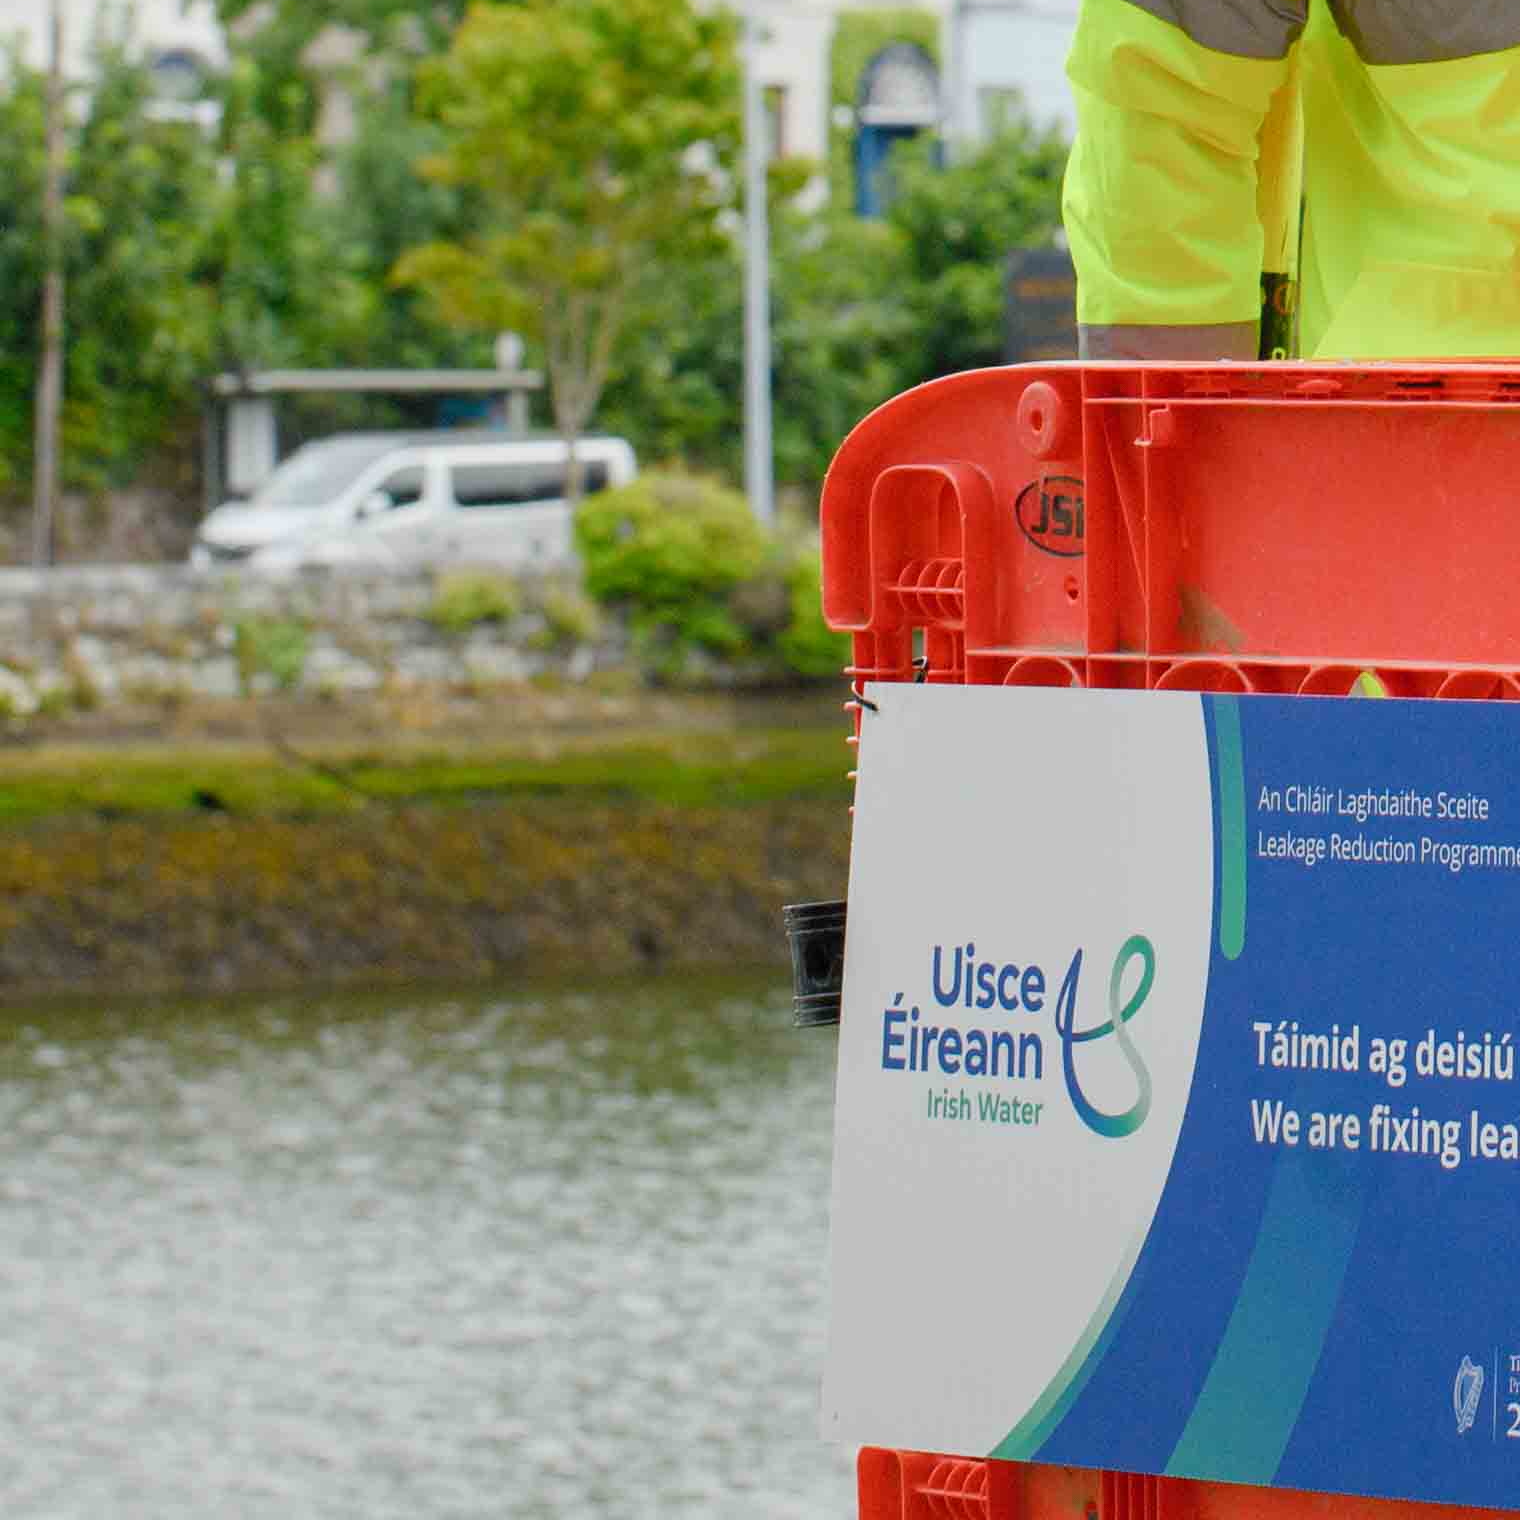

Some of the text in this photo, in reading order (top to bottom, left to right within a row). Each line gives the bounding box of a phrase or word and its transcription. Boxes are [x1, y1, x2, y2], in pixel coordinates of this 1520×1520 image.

[1258, 786, 1489, 822] An Chláir Laghdaithe Sceite
[1258, 831, 1326, 866] Leakage
[1330, 832, 1416, 864] Reduction
[932, 942, 1046, 1012] Uisce
[881, 992, 1043, 1080] Éireann
[1253, 1020, 1360, 1072] Táimid
[1368, 1035, 1408, 1088] ag
[1415, 1029, 1514, 1080] deisiú
[927, 1087, 1044, 1126] Irish Water
[1250, 1099, 1300, 1146] We
[1308, 1110, 1361, 1150] are
[1369, 1103, 1462, 1169] fixing
